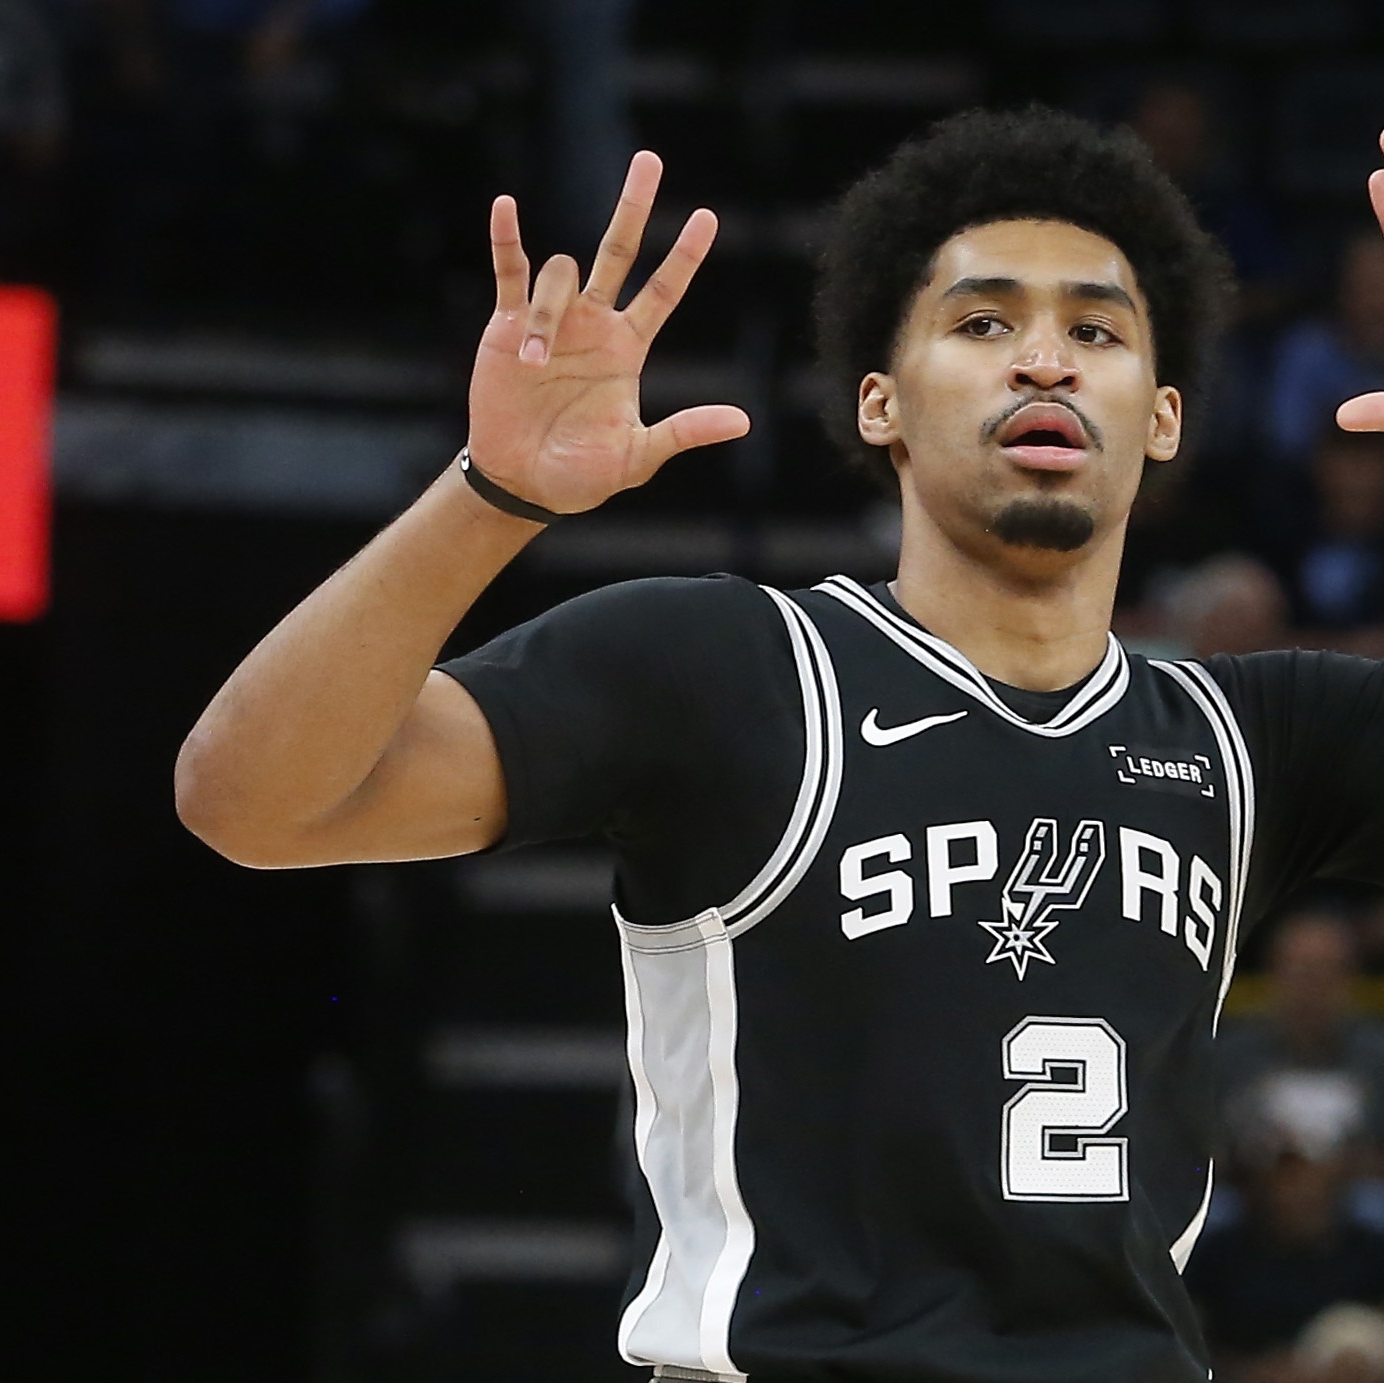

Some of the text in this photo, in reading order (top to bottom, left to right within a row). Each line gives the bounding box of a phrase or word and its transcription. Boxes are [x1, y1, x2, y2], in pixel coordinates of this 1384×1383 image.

[1126, 755, 1203, 784] LEDGER
[839, 818, 1222, 980] SPURS
[1001, 1015, 1130, 1202] 2
